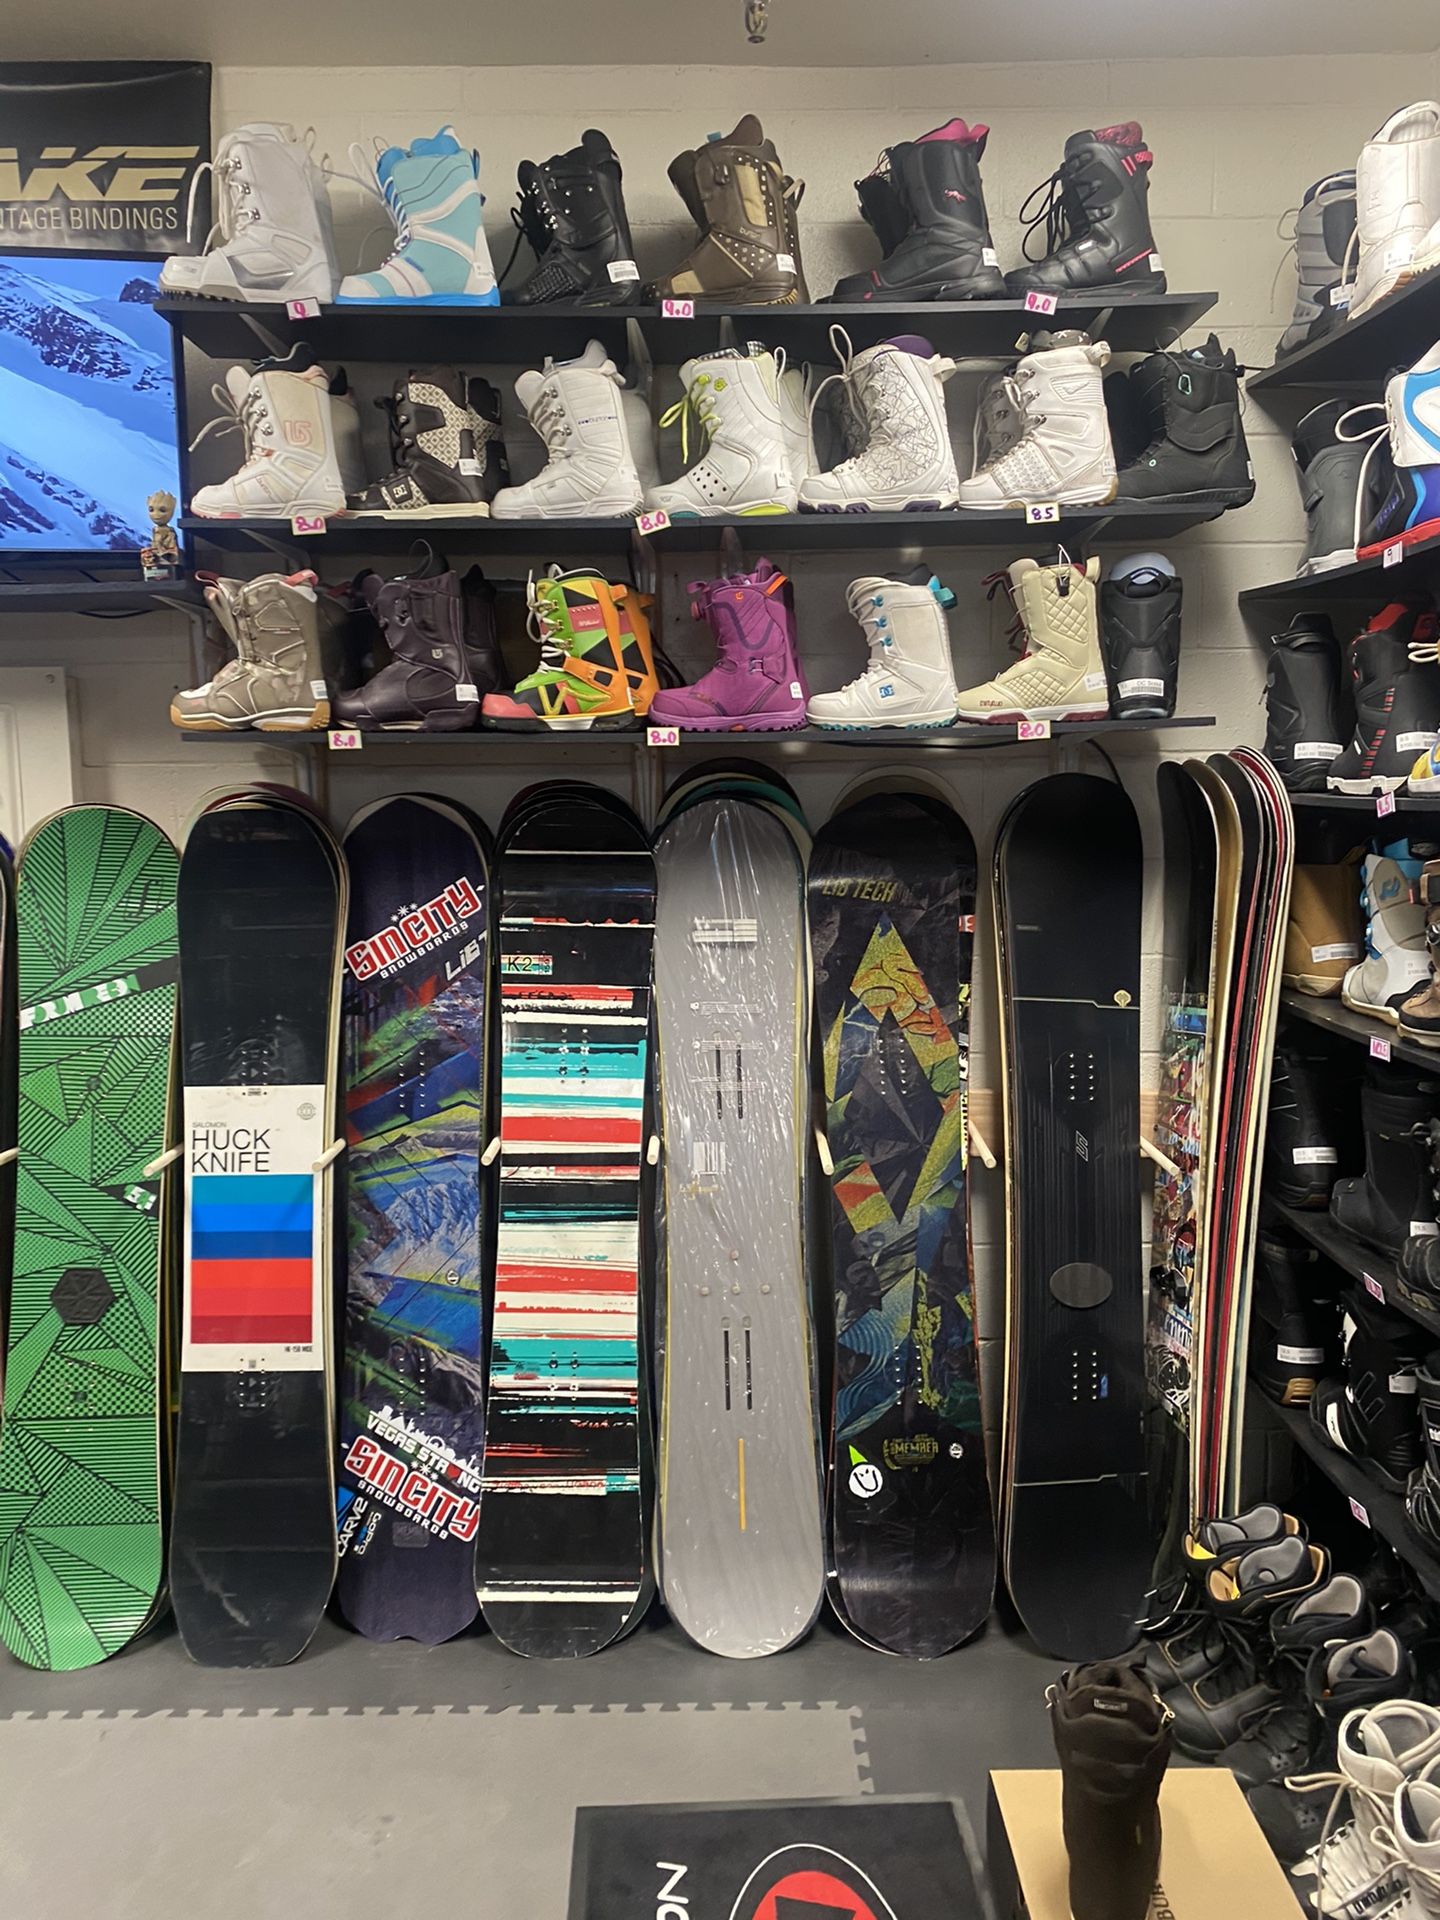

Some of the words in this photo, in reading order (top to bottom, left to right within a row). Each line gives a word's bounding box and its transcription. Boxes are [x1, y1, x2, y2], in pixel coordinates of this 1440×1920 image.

[0, 207, 62, 230] TAGE
[70, 207, 178, 230] BINDINGS
[664, 300, 692, 316] 9.0
[640, 510, 666, 530] 8.0
[333, 732, 356, 747] 8.0
[650, 730, 677, 744] 8.0
[852, 879, 897, 902] TECH
[379, 920, 469, 979] SNOWBOARDS
[507, 956, 533, 972] K2
[192, 1129, 270, 1150] HUCK
[192, 1152, 270, 1172] KNIFE
[366, 1414, 416, 1455] VEGAS
[357, 1480, 450, 1540] SNOWBOARDS
[337, 1496, 368, 1557] CARVE
